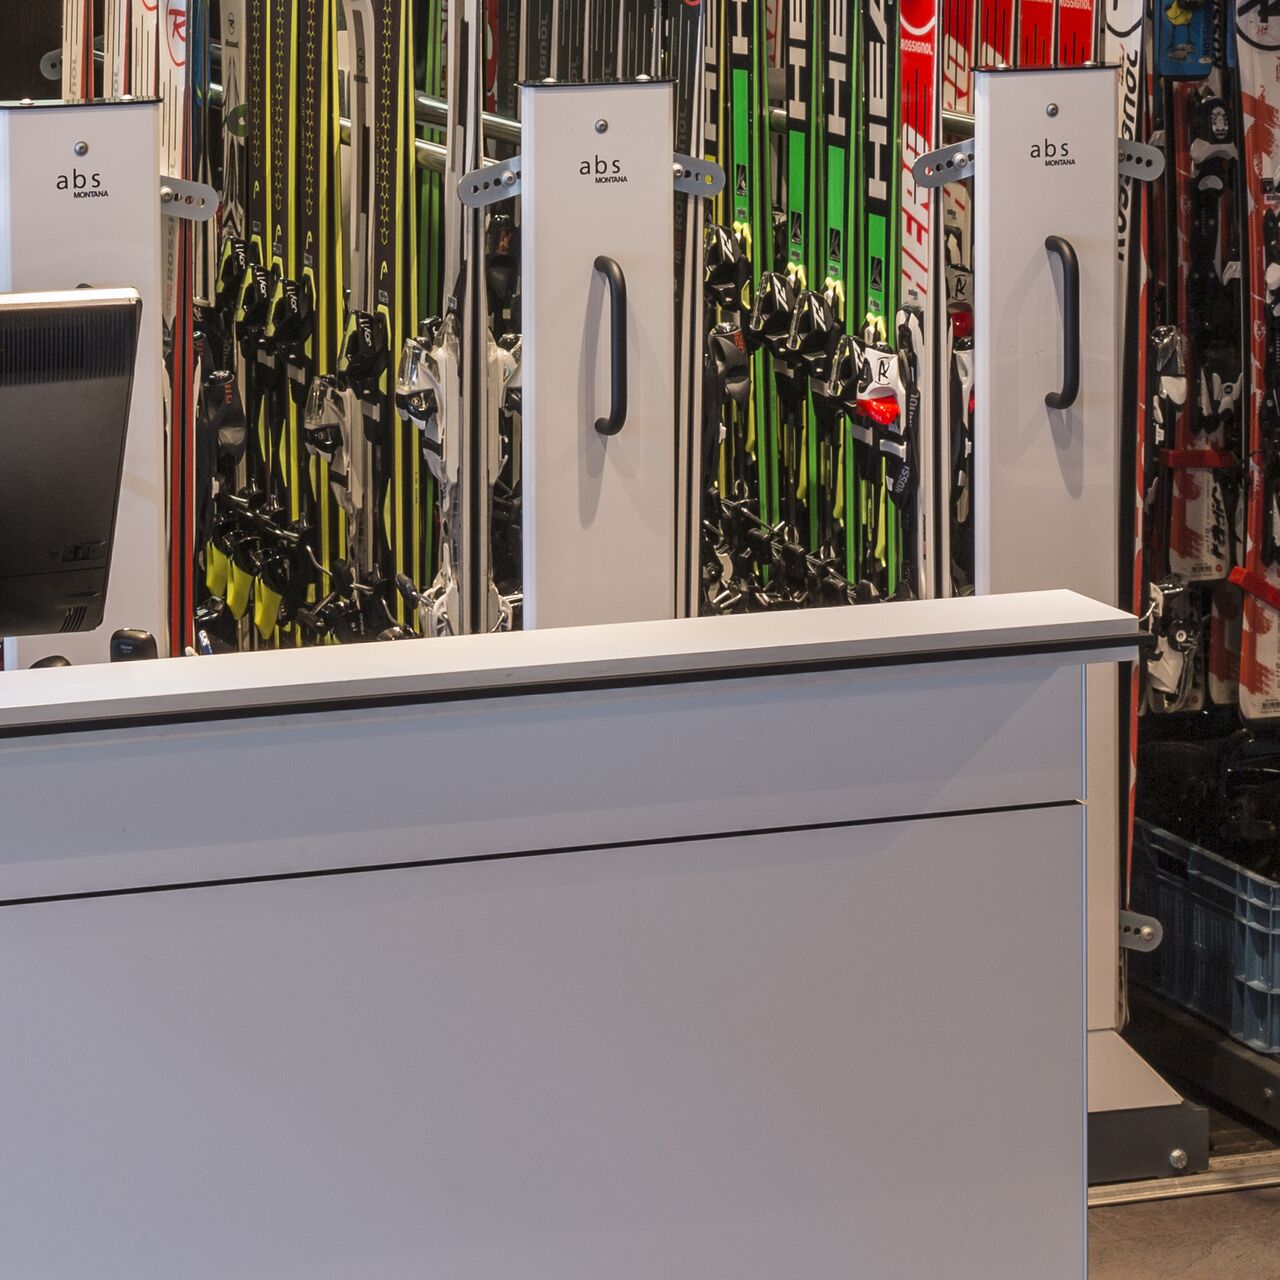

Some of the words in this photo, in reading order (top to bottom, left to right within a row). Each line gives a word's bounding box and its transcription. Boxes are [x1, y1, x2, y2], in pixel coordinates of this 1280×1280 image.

[900, 38, 934, 56] ROSSIGNOL
[1030, 139, 1069, 159] abs
[579, 155, 621, 175] abs
[56, 169, 101, 190] abs
